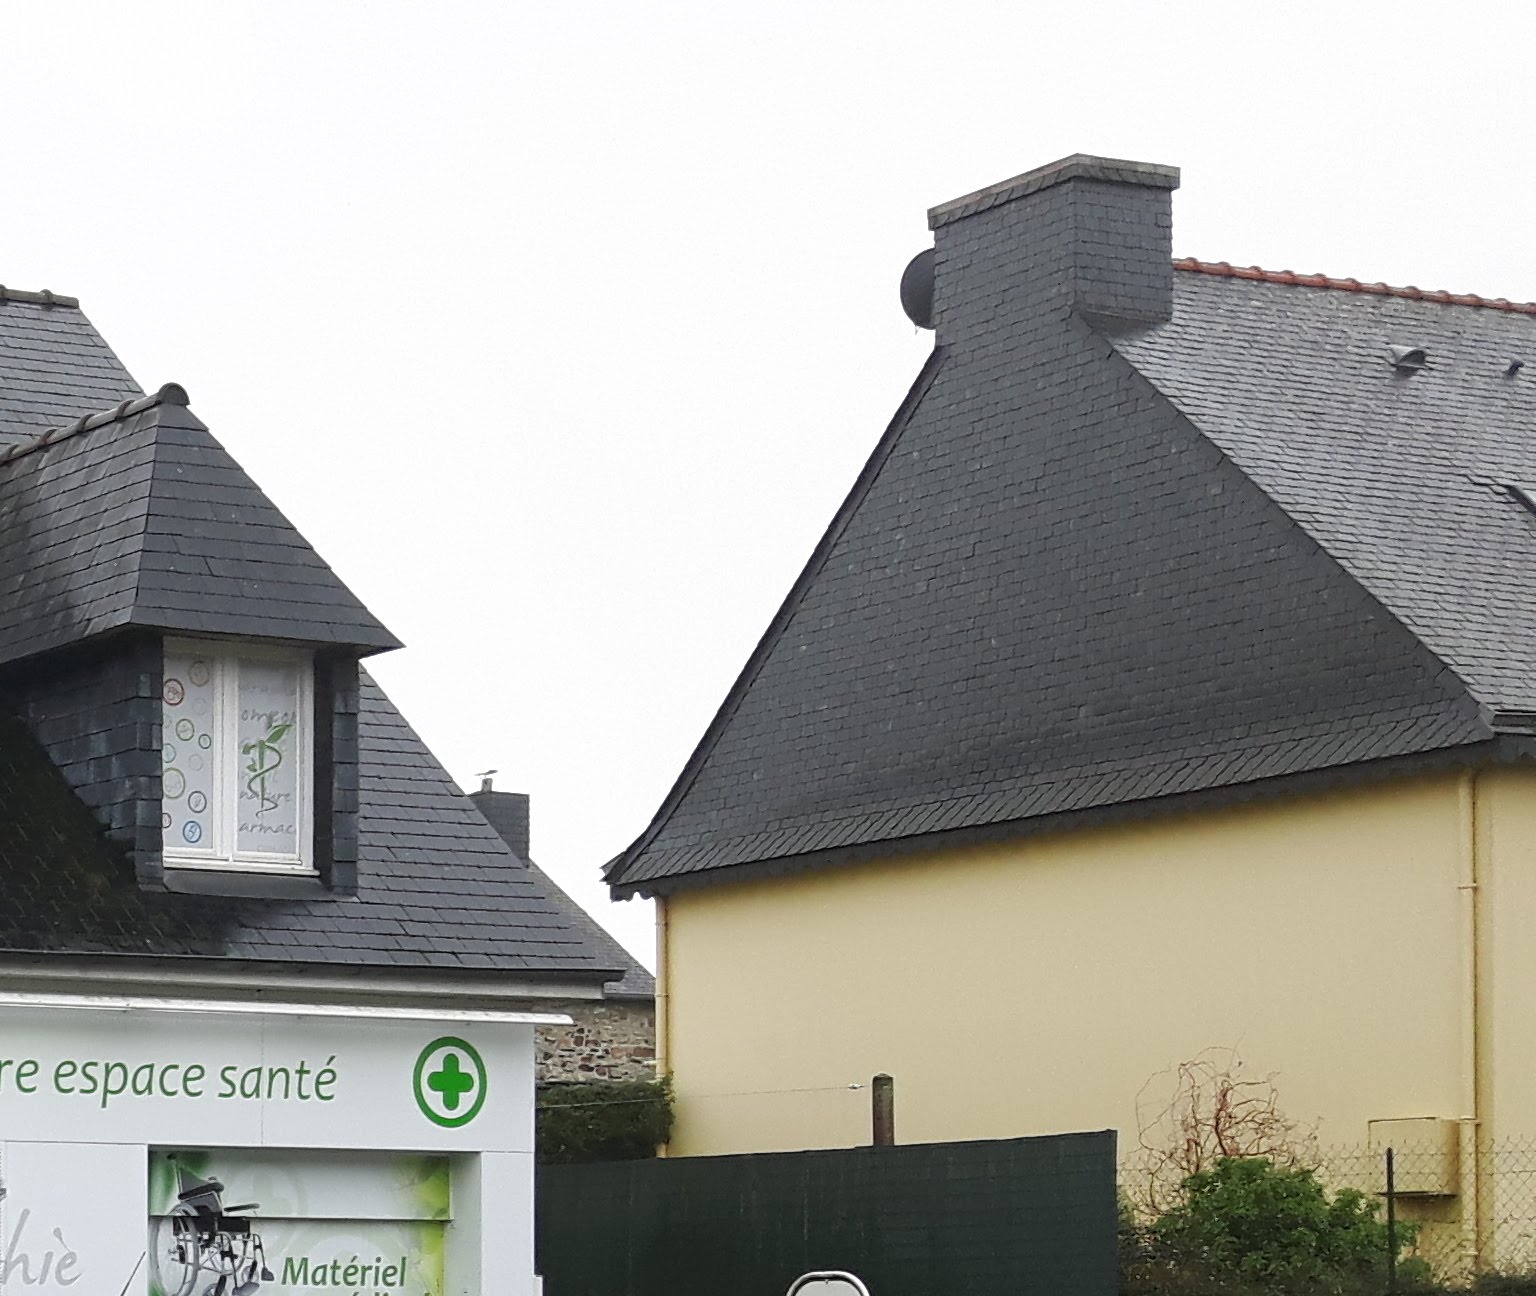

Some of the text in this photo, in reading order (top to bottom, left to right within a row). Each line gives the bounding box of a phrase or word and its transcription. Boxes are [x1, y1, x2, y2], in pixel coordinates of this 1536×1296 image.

[53, 1059, 205, 1108] espace
[217, 1055, 338, 1101] santé
[280, 1255, 407, 1287] Matériel
